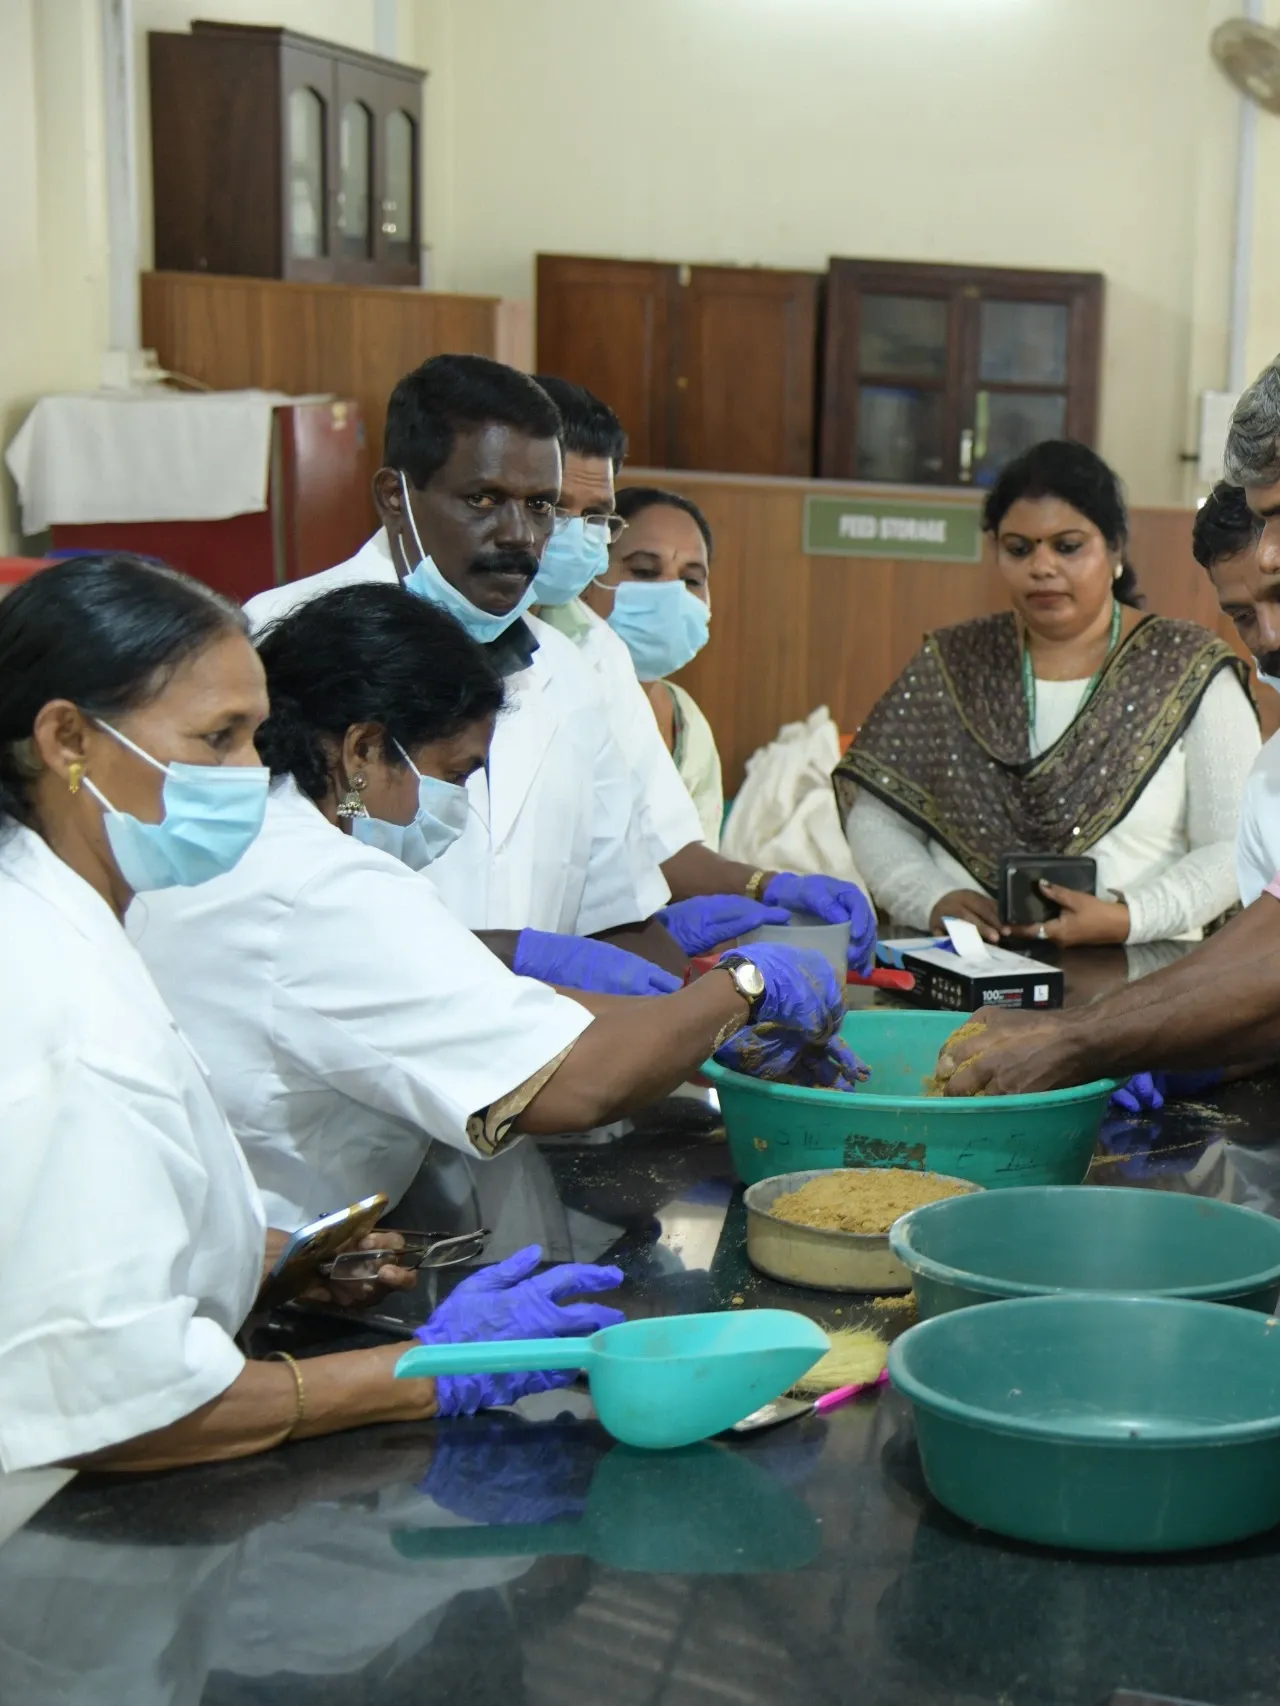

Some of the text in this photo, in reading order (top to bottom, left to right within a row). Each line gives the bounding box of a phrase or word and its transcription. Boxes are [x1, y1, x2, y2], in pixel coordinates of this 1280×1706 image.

[839, 514, 947, 543] FEED STORAGE
[982, 990, 1000, 1001] 100
